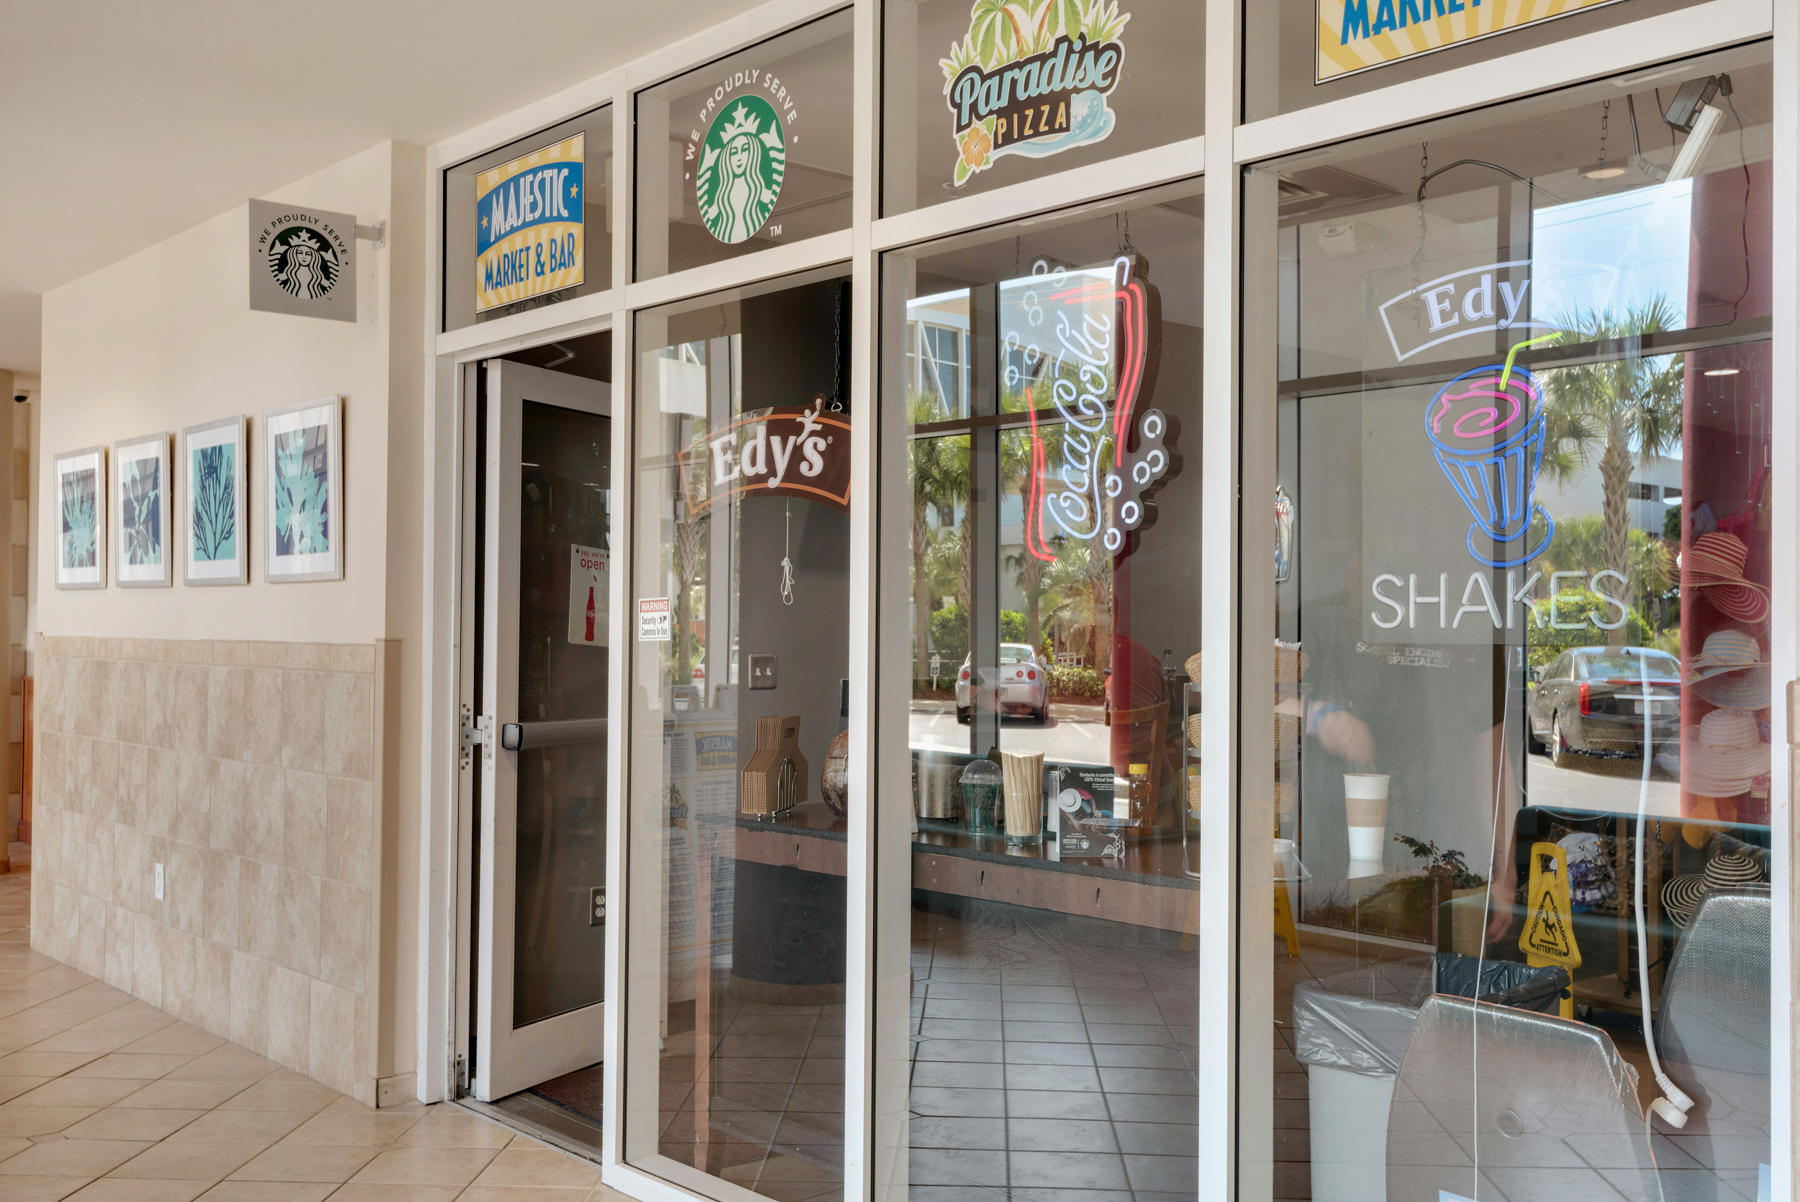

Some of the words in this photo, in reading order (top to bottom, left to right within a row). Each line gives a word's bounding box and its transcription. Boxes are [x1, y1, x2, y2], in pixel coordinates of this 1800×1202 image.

[954, 39, 1117, 126] Paradise
[685, 129, 700, 161] WE
[700, 69, 760, 122] PROUDLY
[763, 73, 797, 125] SERVE
[997, 102, 1067, 144] PIZZA
[490, 168, 569, 243] MAJESTIC
[259, 228, 271, 245] WE
[271, 214, 319, 229] PROUDLY
[322, 224, 348, 255] SERVE
[769, 224, 782, 237] TM
[484, 246, 531, 293] MARKET
[535, 242, 545, 277] &
[550, 232, 575, 274] BAR
[580, 558, 605, 571] open
[641, 601, 668, 612] WARNING
[1371, 569, 1629, 630] SHAKES
[1535, 943, 1563, 957] ATTENTION
